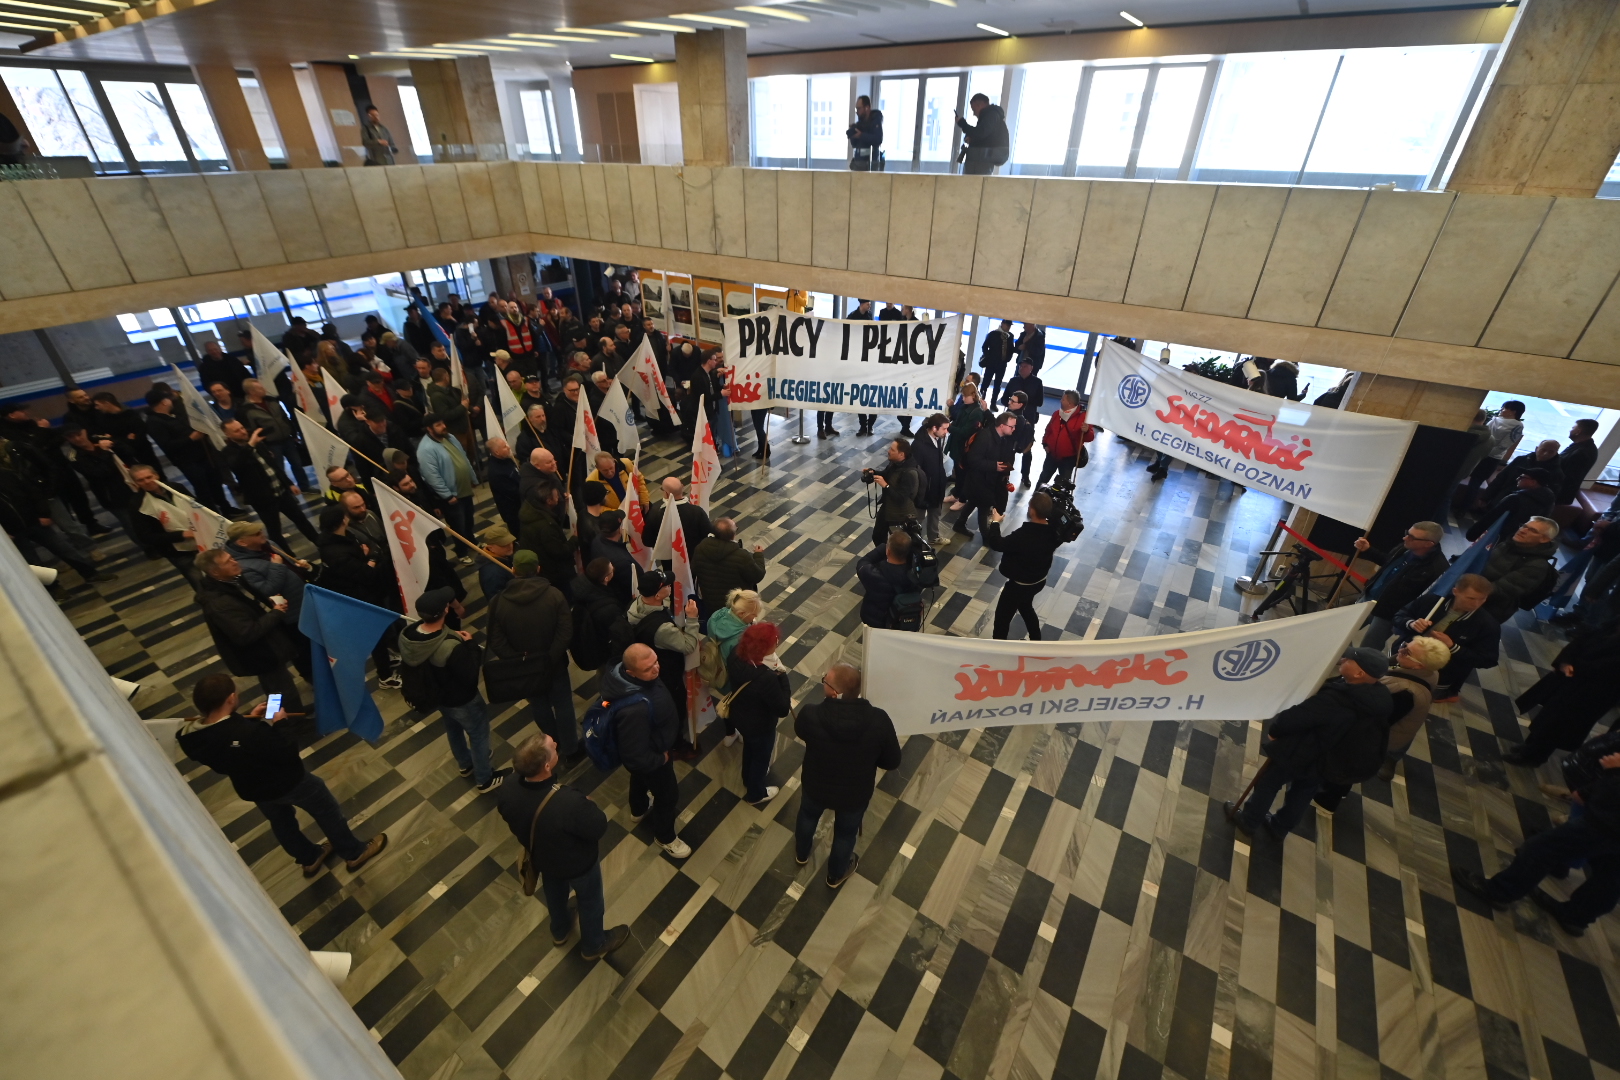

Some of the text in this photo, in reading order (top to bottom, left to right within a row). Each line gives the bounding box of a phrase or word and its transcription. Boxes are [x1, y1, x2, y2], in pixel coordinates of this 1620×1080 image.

[738, 315, 947, 365] PRACY I PŁACY
[767, 377, 943, 411] H.CEGIELSKI-POZNAŃ S.A.
[1134, 422, 1312, 500] H. CEGIELSKI POZNAŃ
